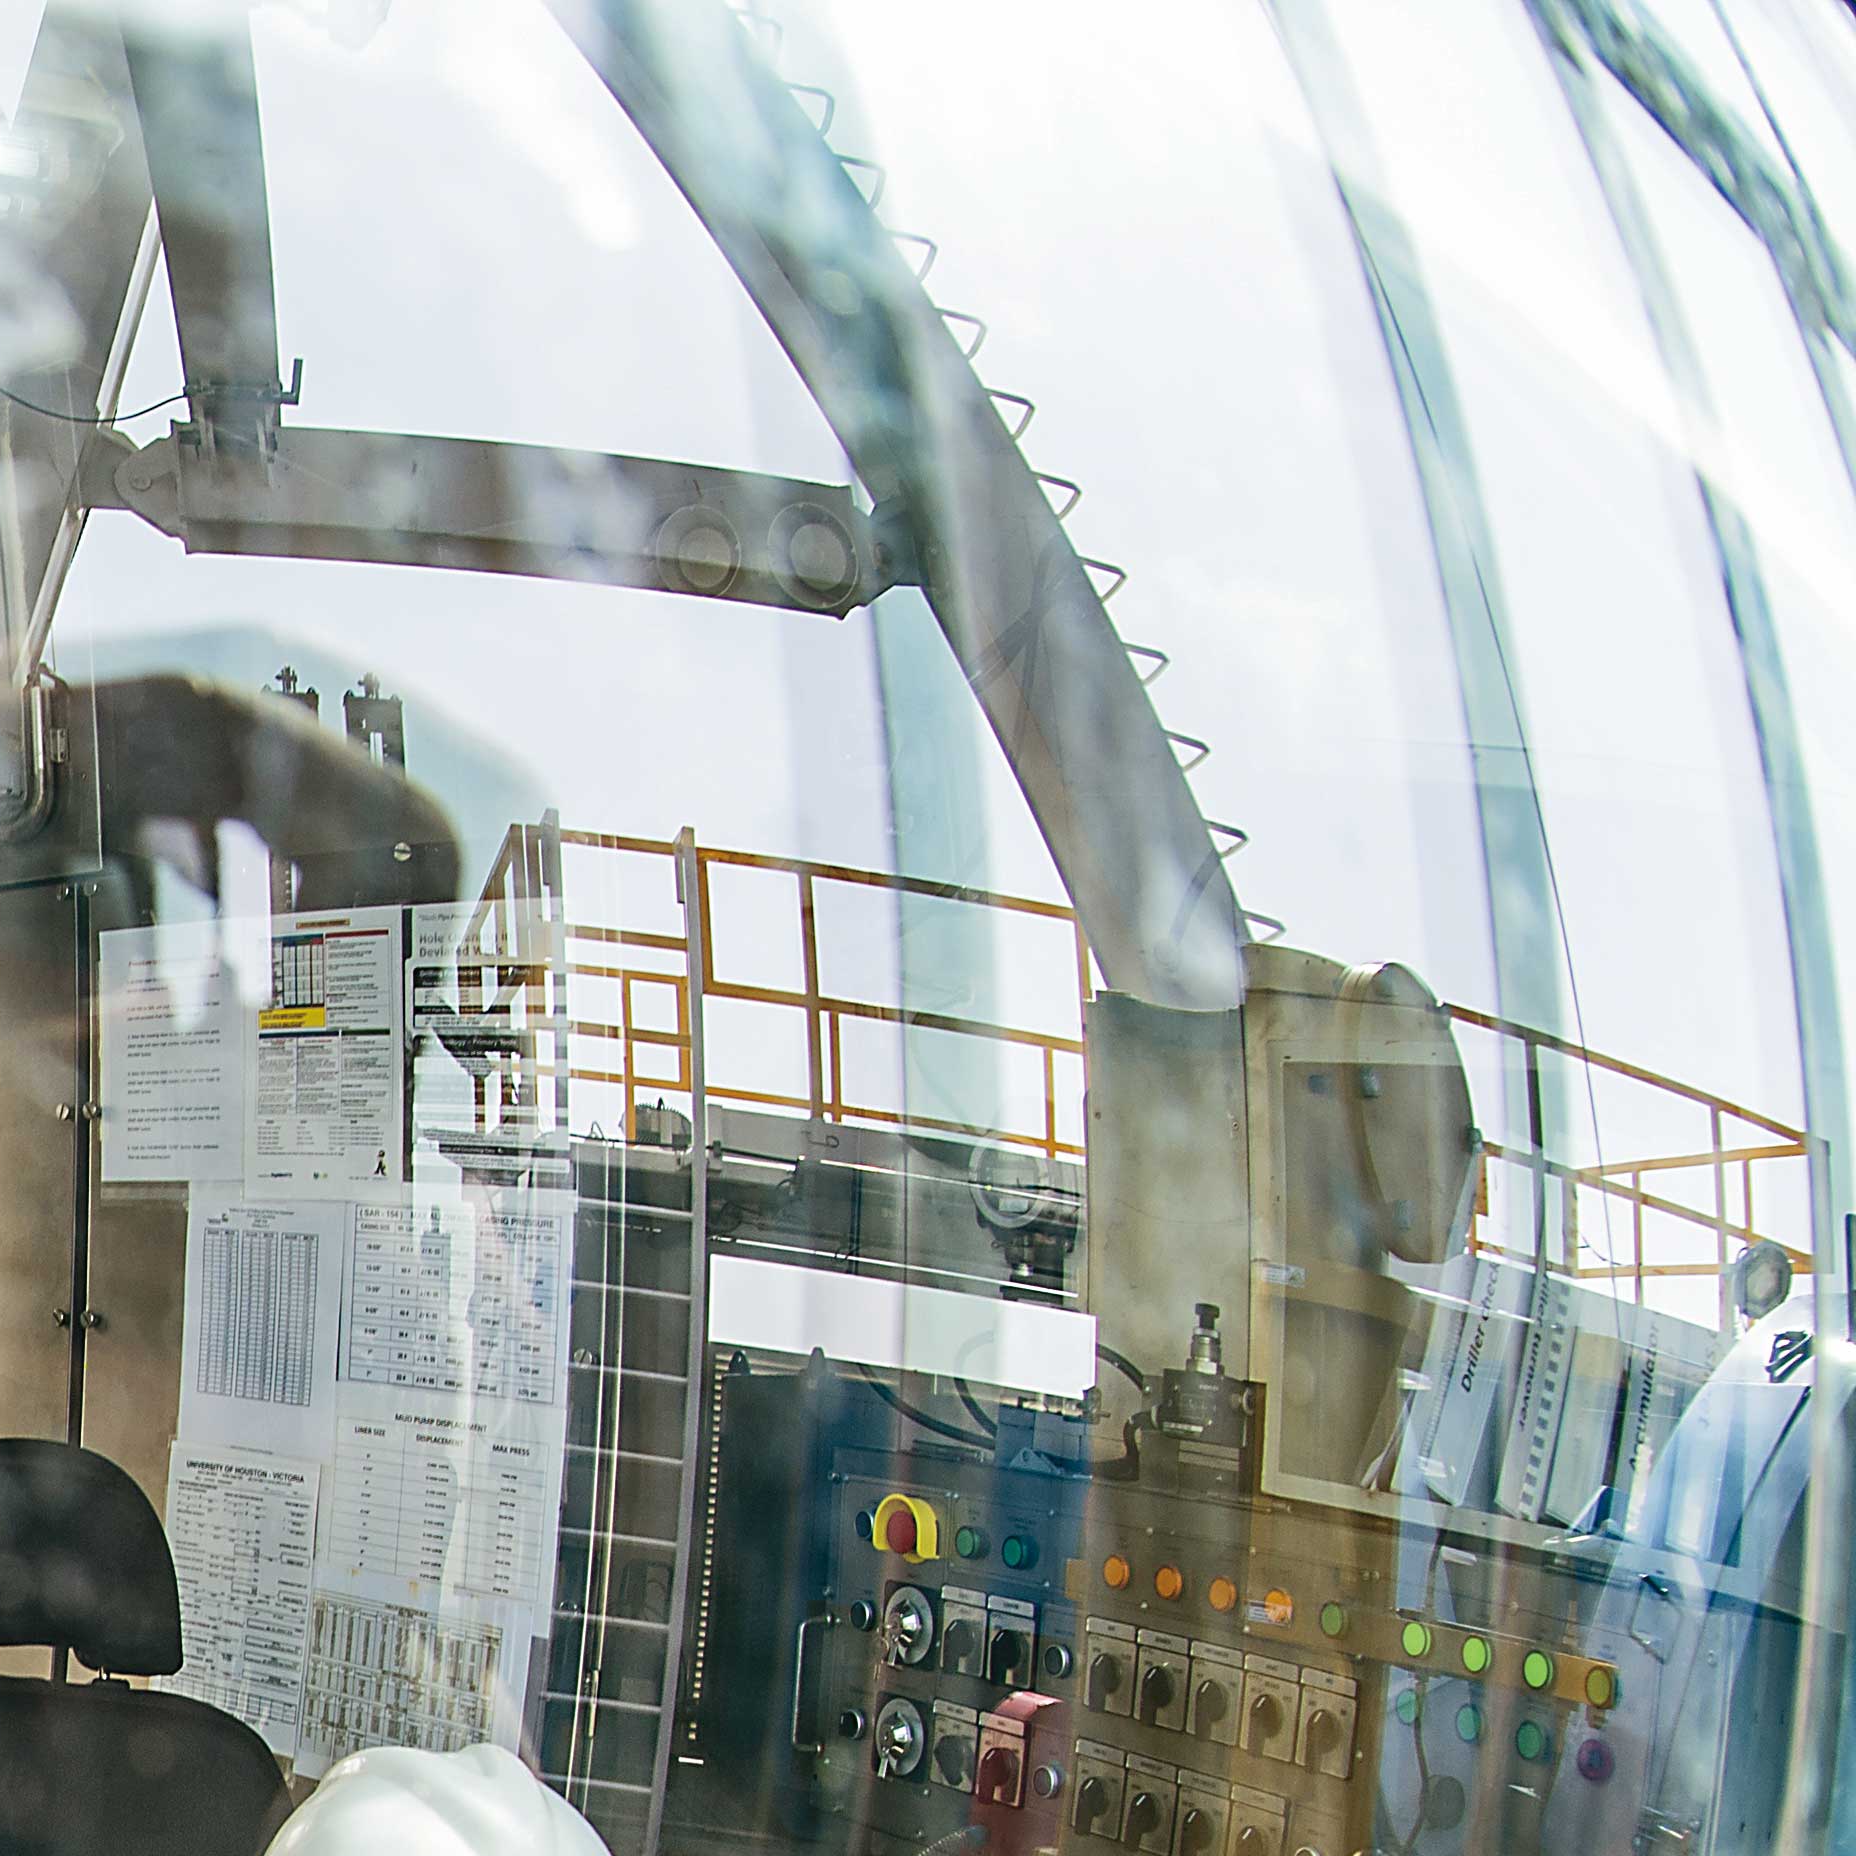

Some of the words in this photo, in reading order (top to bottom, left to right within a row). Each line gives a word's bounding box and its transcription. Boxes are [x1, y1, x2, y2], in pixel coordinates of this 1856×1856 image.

[1460, 1325, 1486, 1393] Driller
[492, 1444, 508, 1454] MAX
[509, 1445, 530, 1457] PRESS
[186, 1460, 223, 1472] UNIVERSITY
[224, 1464, 233, 1473] OF
[234, 1466, 267, 1479] HOUSTON
[272, 1471, 304, 1483] VICTORIA
